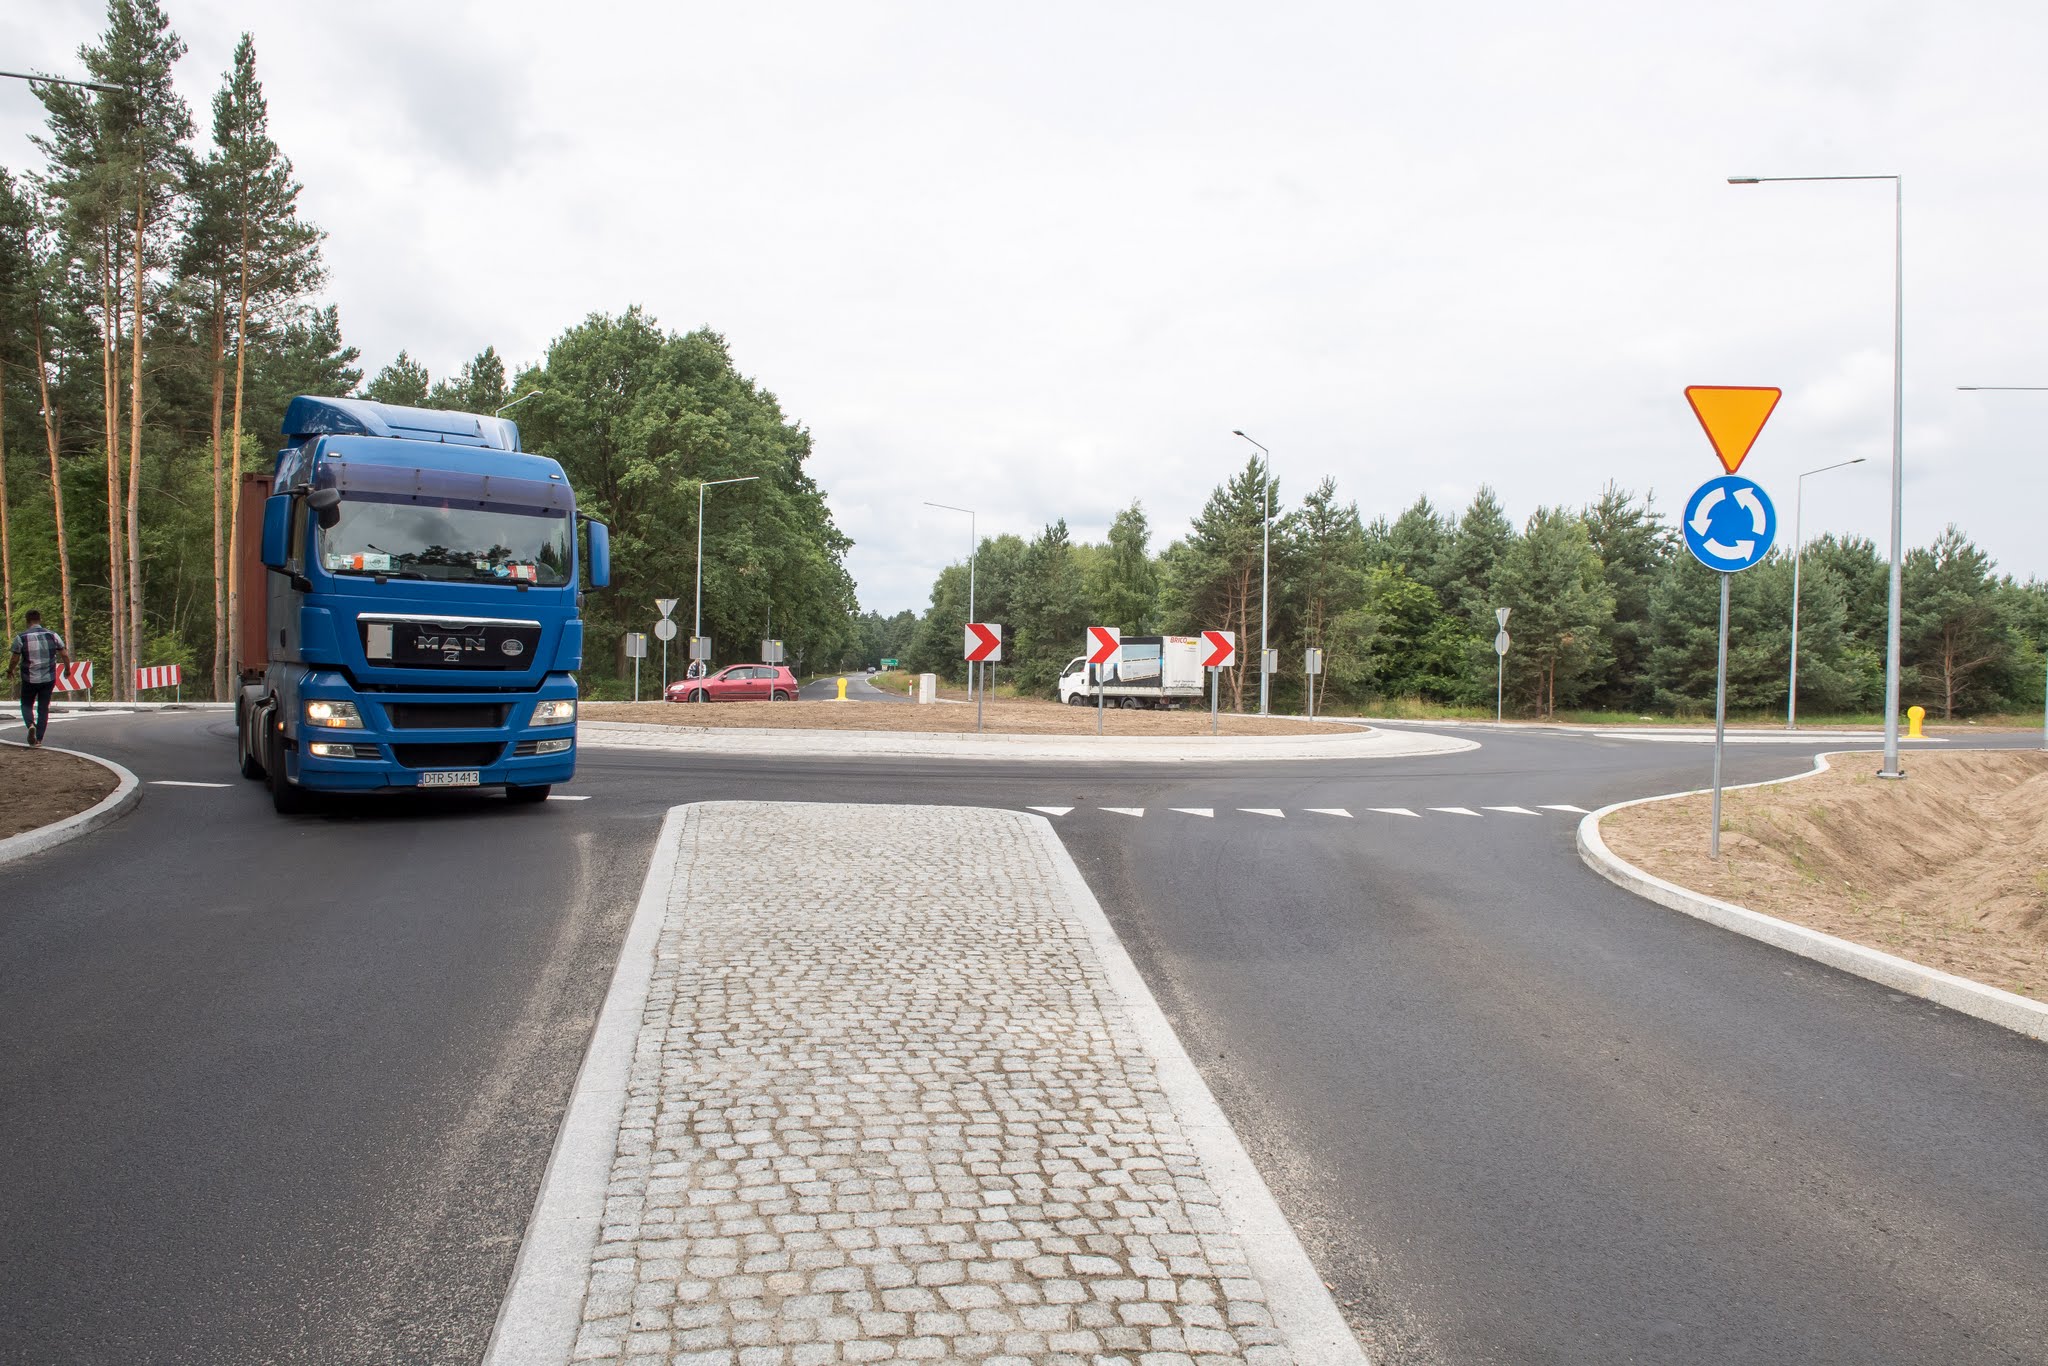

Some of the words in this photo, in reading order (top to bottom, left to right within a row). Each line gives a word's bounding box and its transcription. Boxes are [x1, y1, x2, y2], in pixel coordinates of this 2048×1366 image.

[418, 636, 485, 651] MAN
[424, 773, 445, 784] DTR
[447, 772, 478, 783] 51413
